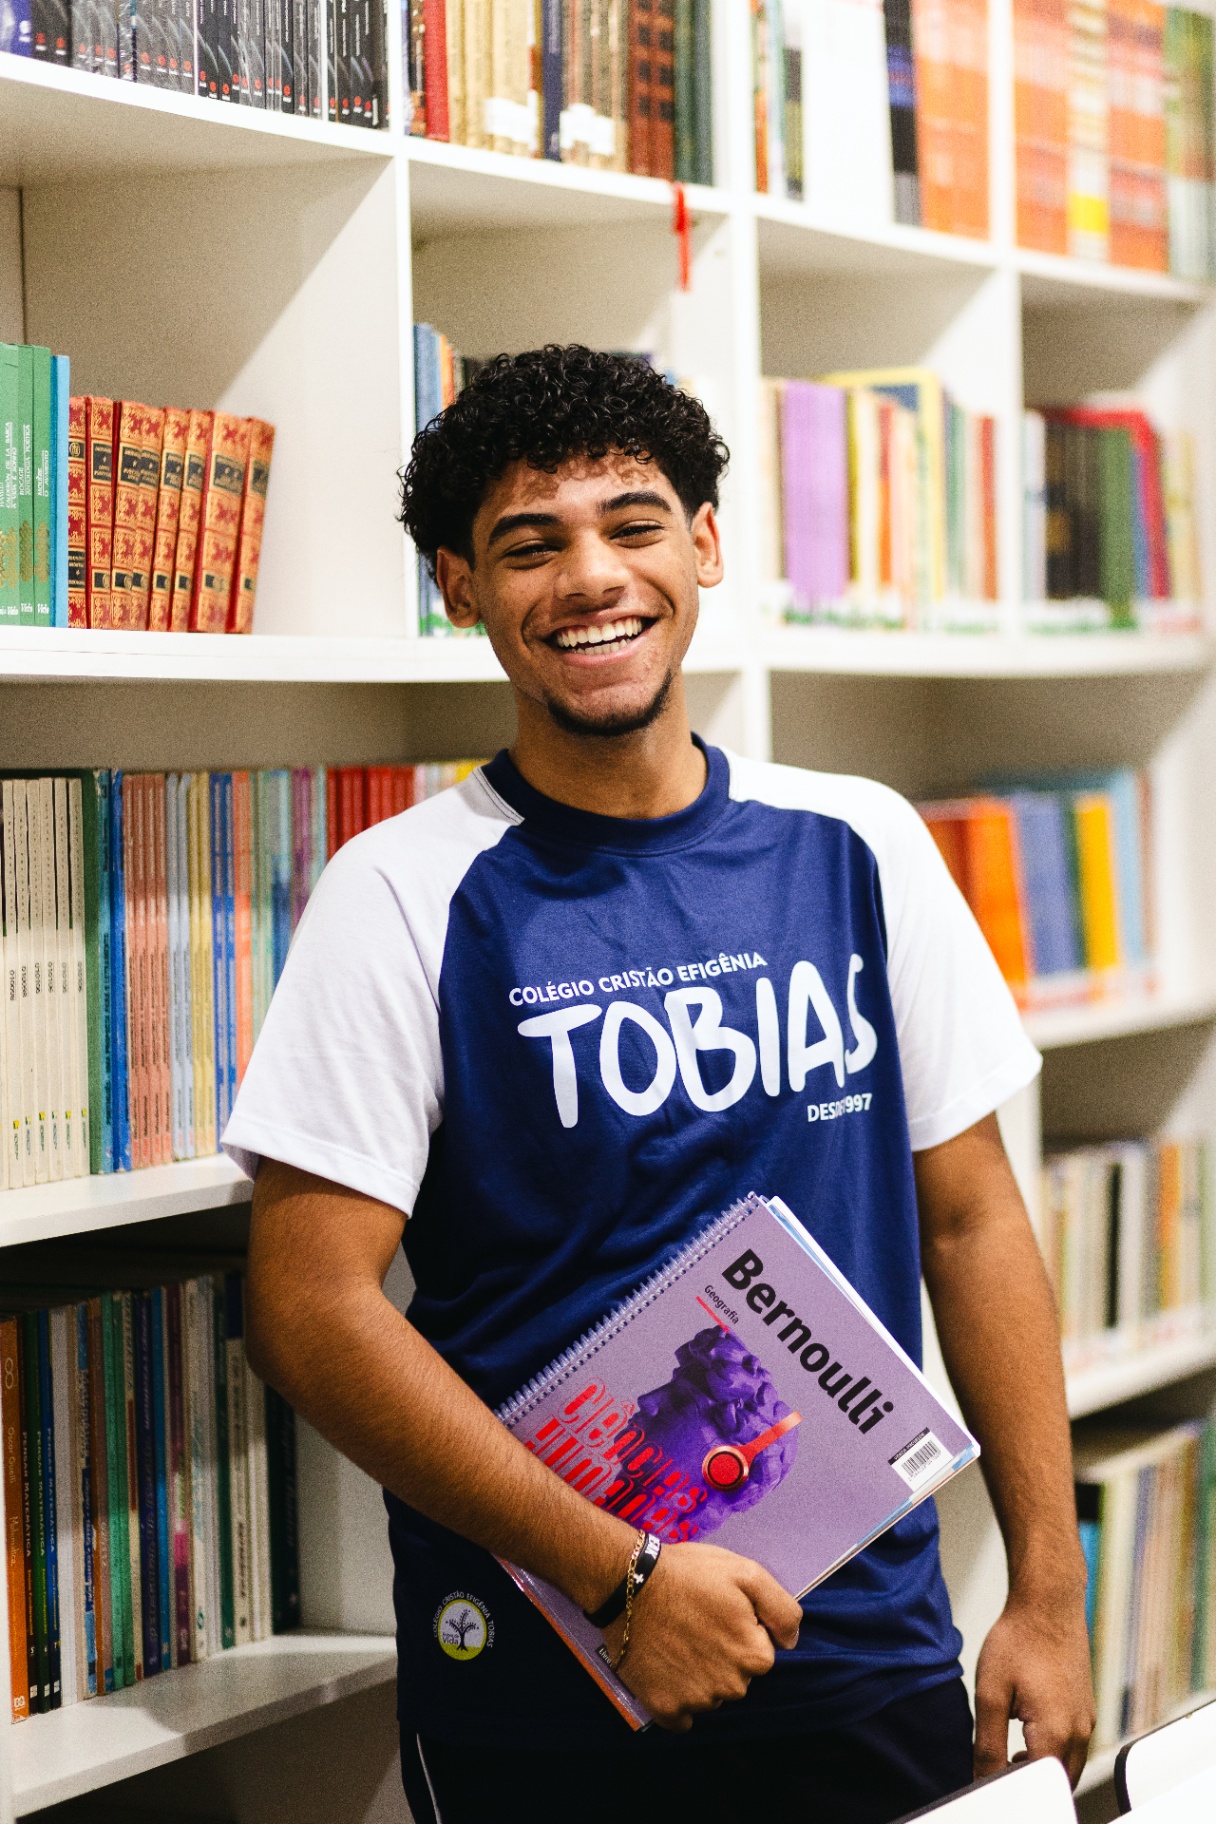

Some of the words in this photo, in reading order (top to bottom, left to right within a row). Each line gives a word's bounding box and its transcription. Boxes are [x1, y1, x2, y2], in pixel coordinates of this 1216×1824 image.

[508, 979, 595, 1007] COLÉGIO
[598, 967, 673, 994] CRISTÃO
[678, 952, 768, 983] EFIGÊNIA
[517, 952, 878, 1129] TOBIAS
[842, 1092, 873, 1114] 997
[702, 1284, 741, 1326] Geografia
[721, 1248, 896, 1436] Bernoulli
